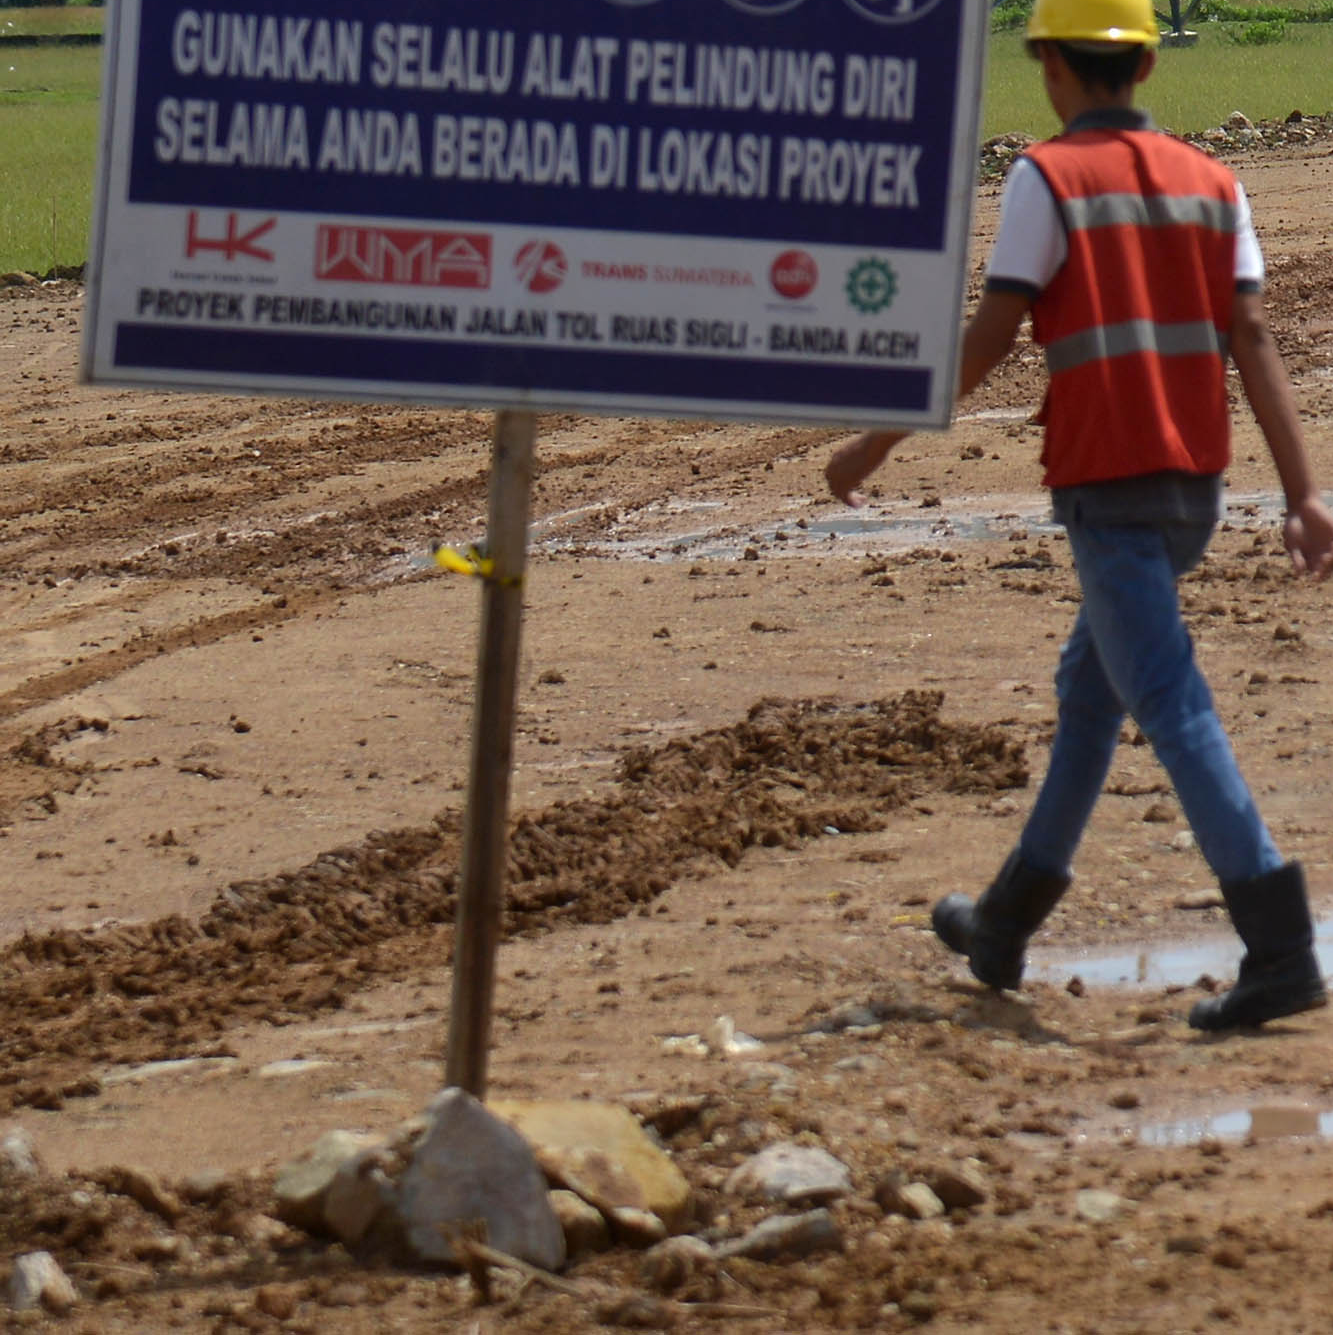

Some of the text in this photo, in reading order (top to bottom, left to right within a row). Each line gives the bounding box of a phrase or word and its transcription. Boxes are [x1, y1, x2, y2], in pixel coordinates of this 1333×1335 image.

[172, 9, 917, 120] GUNAKAN SELALU ALAT PELINDUNG DIRI
[156, 96, 921, 207] SELAMA ANDA BERADA DI LOKASI PROYEK
[184, 209, 277, 262] HK
[319, 226, 490, 286] WMA
[582, 260, 648, 282] TRANS
[653, 263, 755, 288] SUMATERA
[138, 288, 245, 322] PROYEK
[254, 295, 456, 334] PEMBANGUNAN
[465, 306, 546, 338] JALAN
[557, 311, 603, 341] TOL
[613, 314, 678, 345] RUAS
[685, 318, 748, 350] SIGLI
[769, 324, 848, 355] BANDA
[857, 328, 920, 360] ACEH
